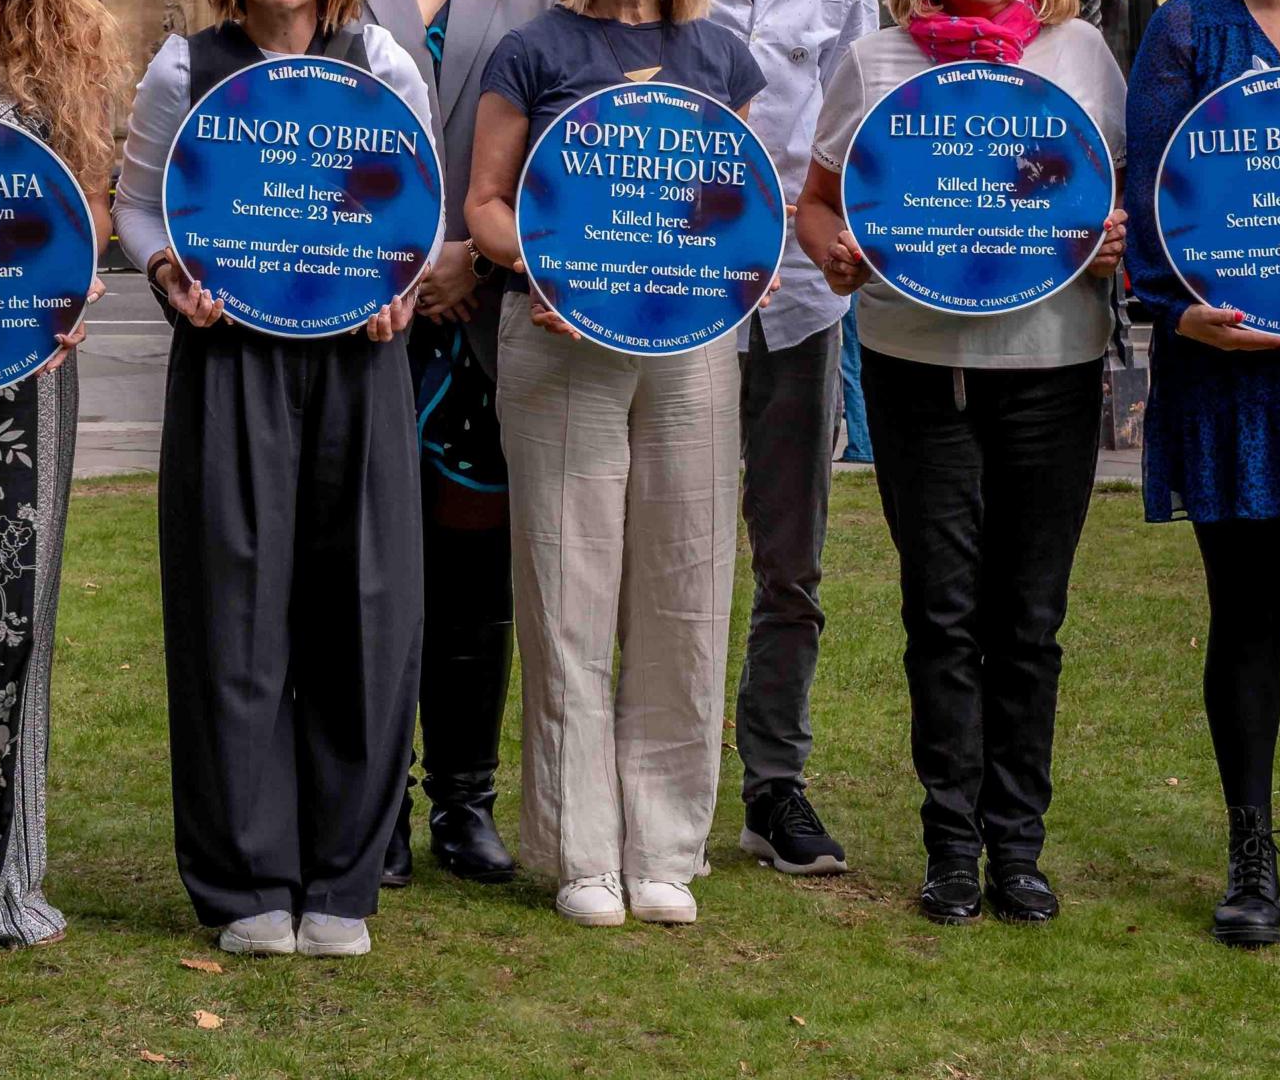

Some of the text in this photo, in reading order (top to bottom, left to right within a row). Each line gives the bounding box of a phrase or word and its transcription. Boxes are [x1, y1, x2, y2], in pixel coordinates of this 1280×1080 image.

[197, 114, 417, 155] ELINOR O'BRIEN
[890, 114, 1067, 138] ELLIE GOULD
[565, 120, 746, 156] POPPY DEVEY
[1189, 129, 1257, 159] JULIE
[261, 149, 297, 165] 1999
[311, 152, 353, 170] 2022
[932, 142, 973, 156] 2002
[988, 143, 1025, 157] 2019
[561, 150, 746, 185] WATERHOUSE
[263, 182, 345, 202] Killed here.
[611, 183, 645, 199] 1994
[659, 185, 695, 202] 2018
[938, 177, 1017, 192] Killed here.
[232, 199, 372, 225] Sentence: 23 years
[903, 193, 1050, 212] Sentence: 12.5 years
[612, 210, 691, 229] Killed here.
[584, 224, 716, 249] Sentence: 16 years
[865, 222, 1089, 239] The same murder outside the home
[895, 240, 1057, 256] would get a decade more.
[8, 295, 29, 309] the
[33, 295, 71, 308] home
[2, 318, 39, 328] more.
[570, 309, 605, 335] MURDER
[604, 328, 612, 338] IS
[652, 334, 689, 347] CHANGE
[690, 328, 708, 341] THE
[707, 319, 725, 334] LAW
[3, 364, 20, 377] THE
[19, 352, 39, 368] LAW
